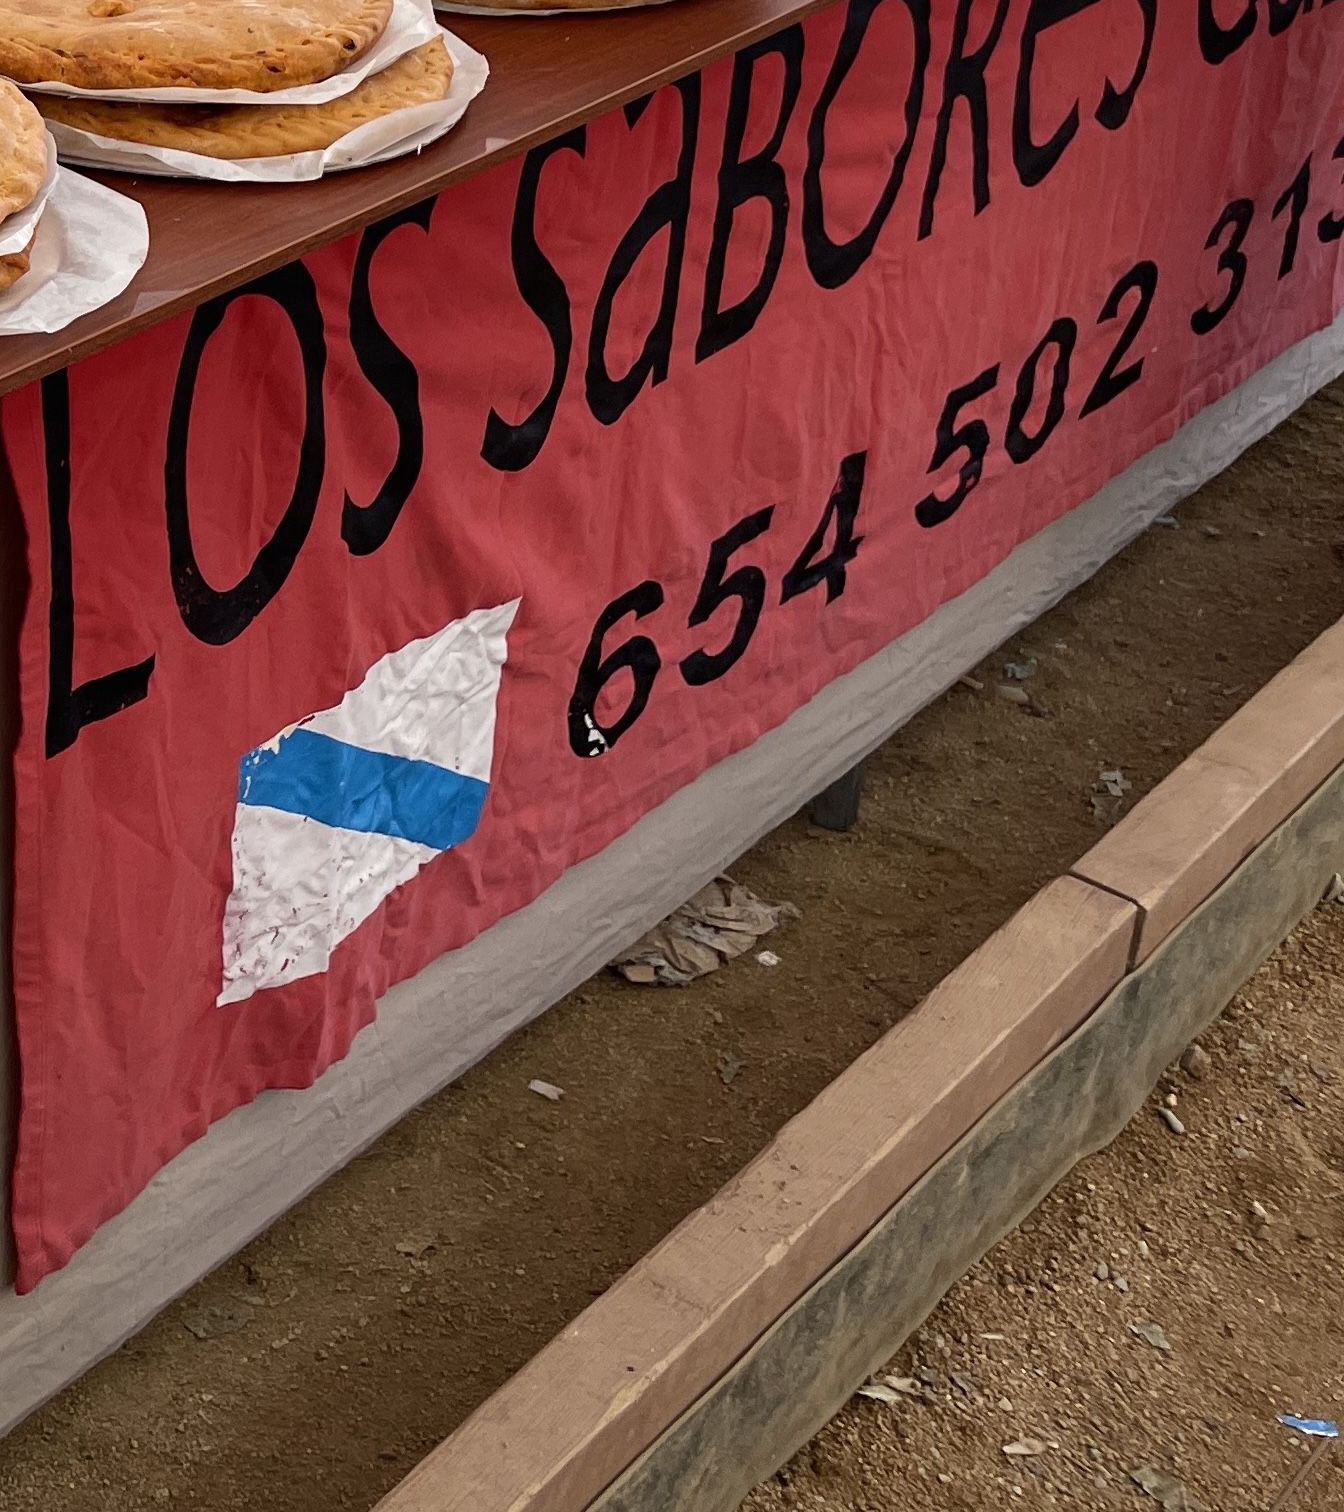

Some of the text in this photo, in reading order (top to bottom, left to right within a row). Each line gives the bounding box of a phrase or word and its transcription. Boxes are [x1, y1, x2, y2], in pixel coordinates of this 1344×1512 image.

[40, 192, 441, 761] LOS
[566, 449, 868, 759] 654
[913, 258, 1160, 529] 502
